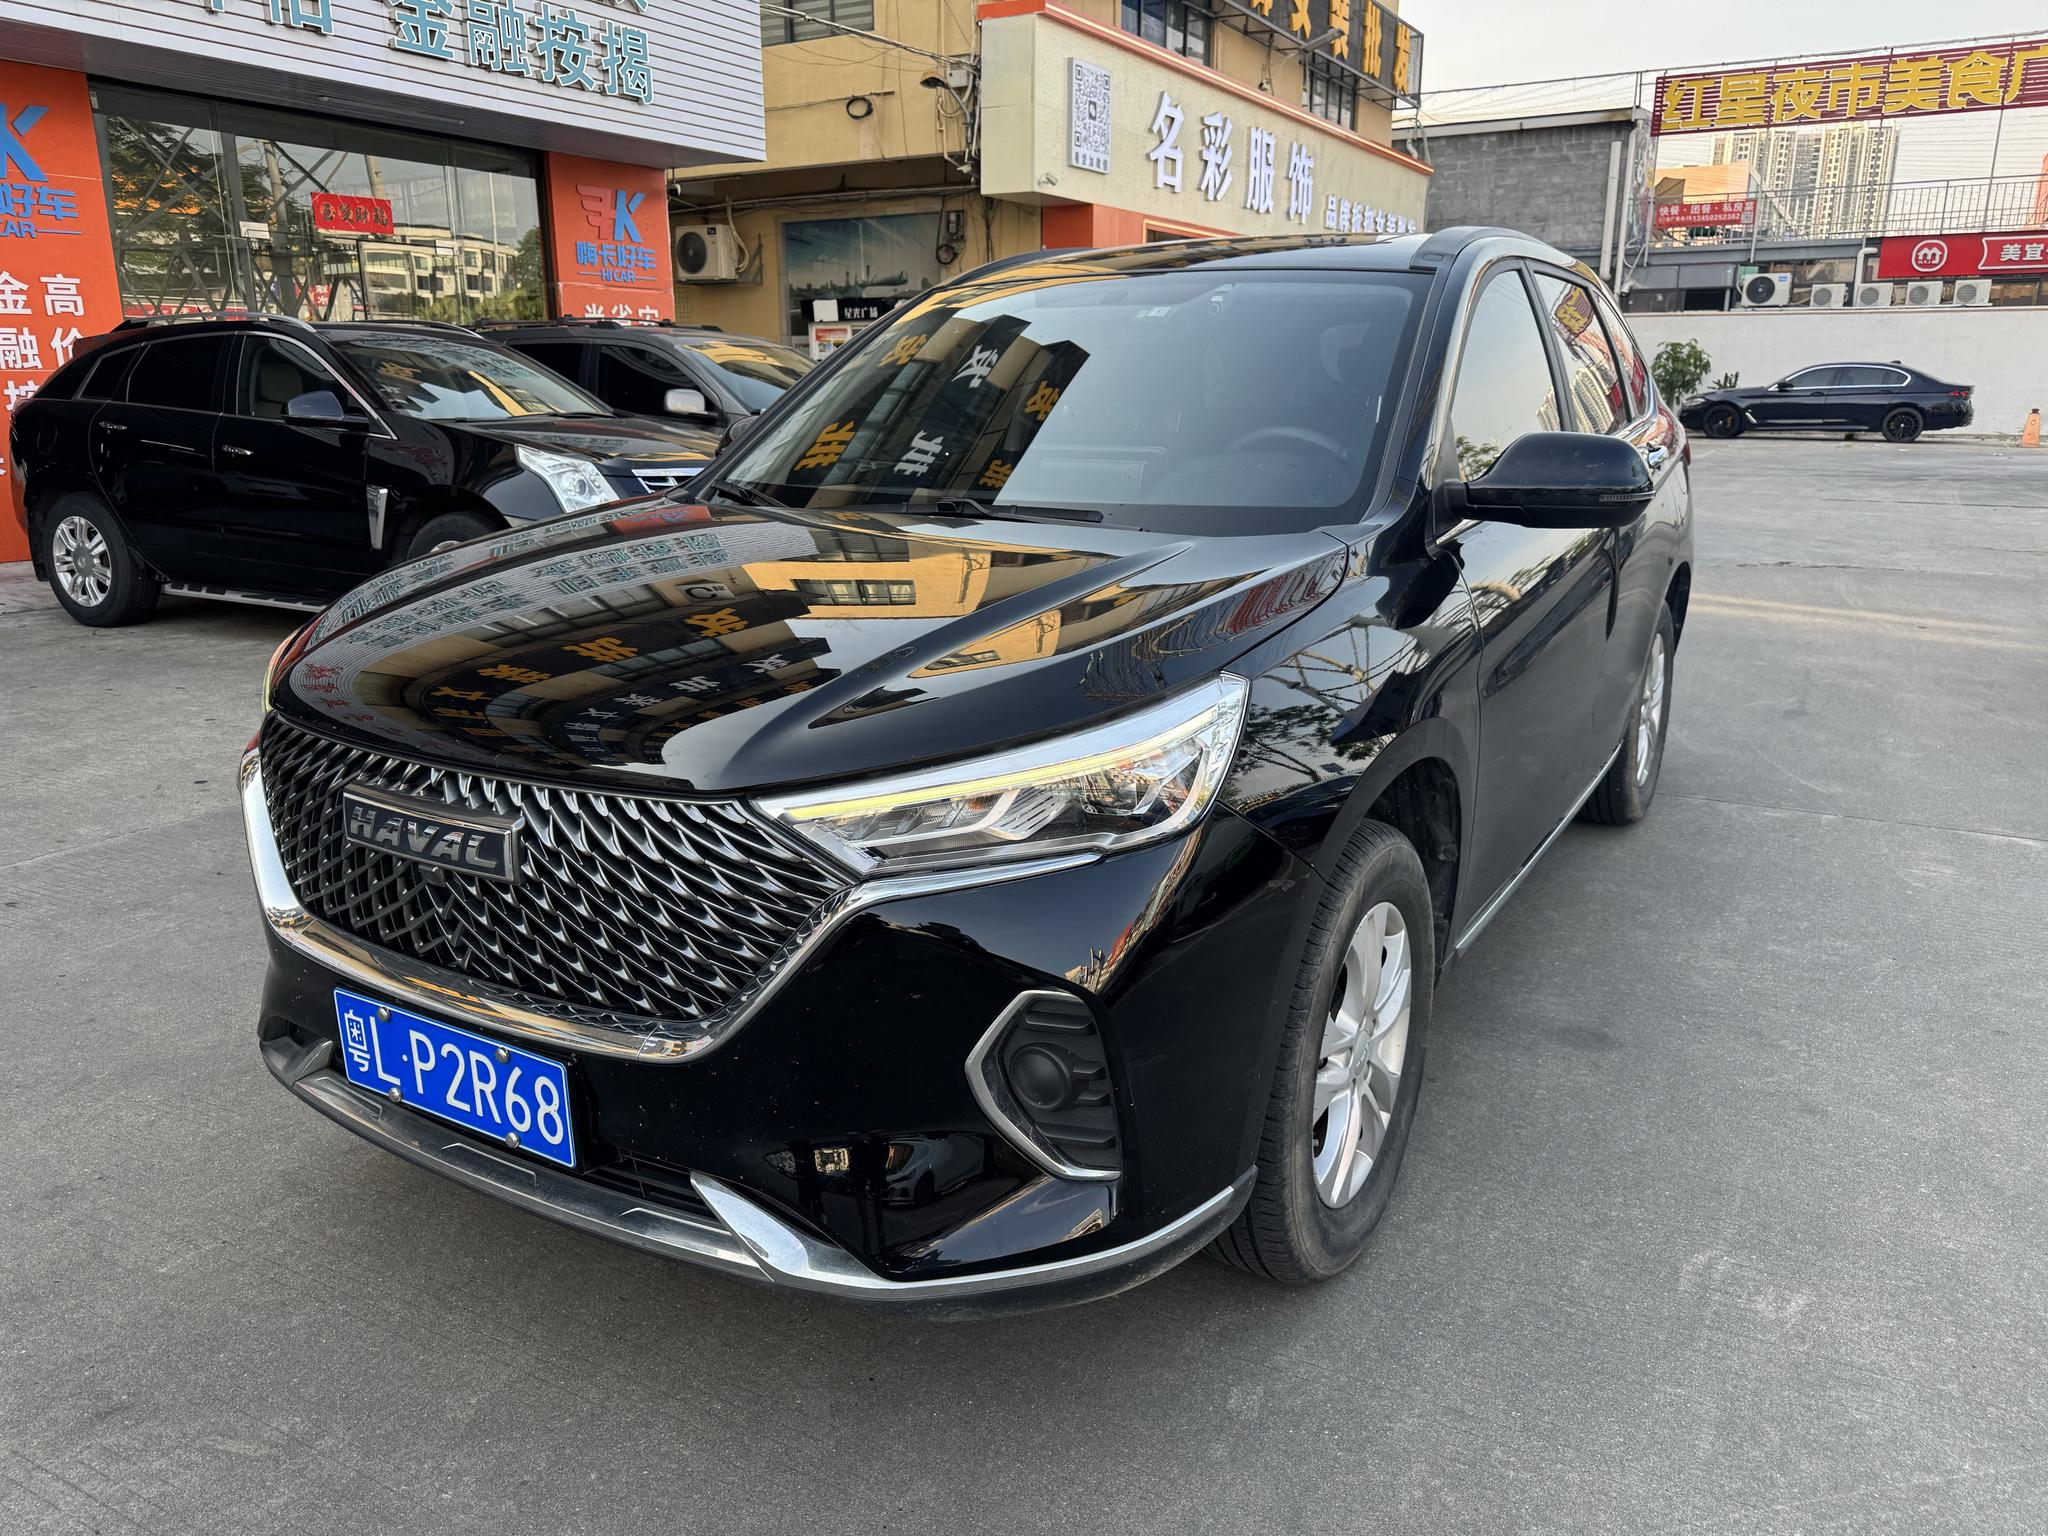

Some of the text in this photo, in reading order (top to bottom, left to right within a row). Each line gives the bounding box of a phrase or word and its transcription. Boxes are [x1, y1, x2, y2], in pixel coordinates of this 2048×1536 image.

[393, 0, 655, 104] 金融按揭
[1148, 90, 1315, 224] 名彩服饰
[575, 241, 657, 271] 嗨卡好车
[2000, 243, 2048, 261] 美宜
[350, 806, 497, 869] HAVAL
